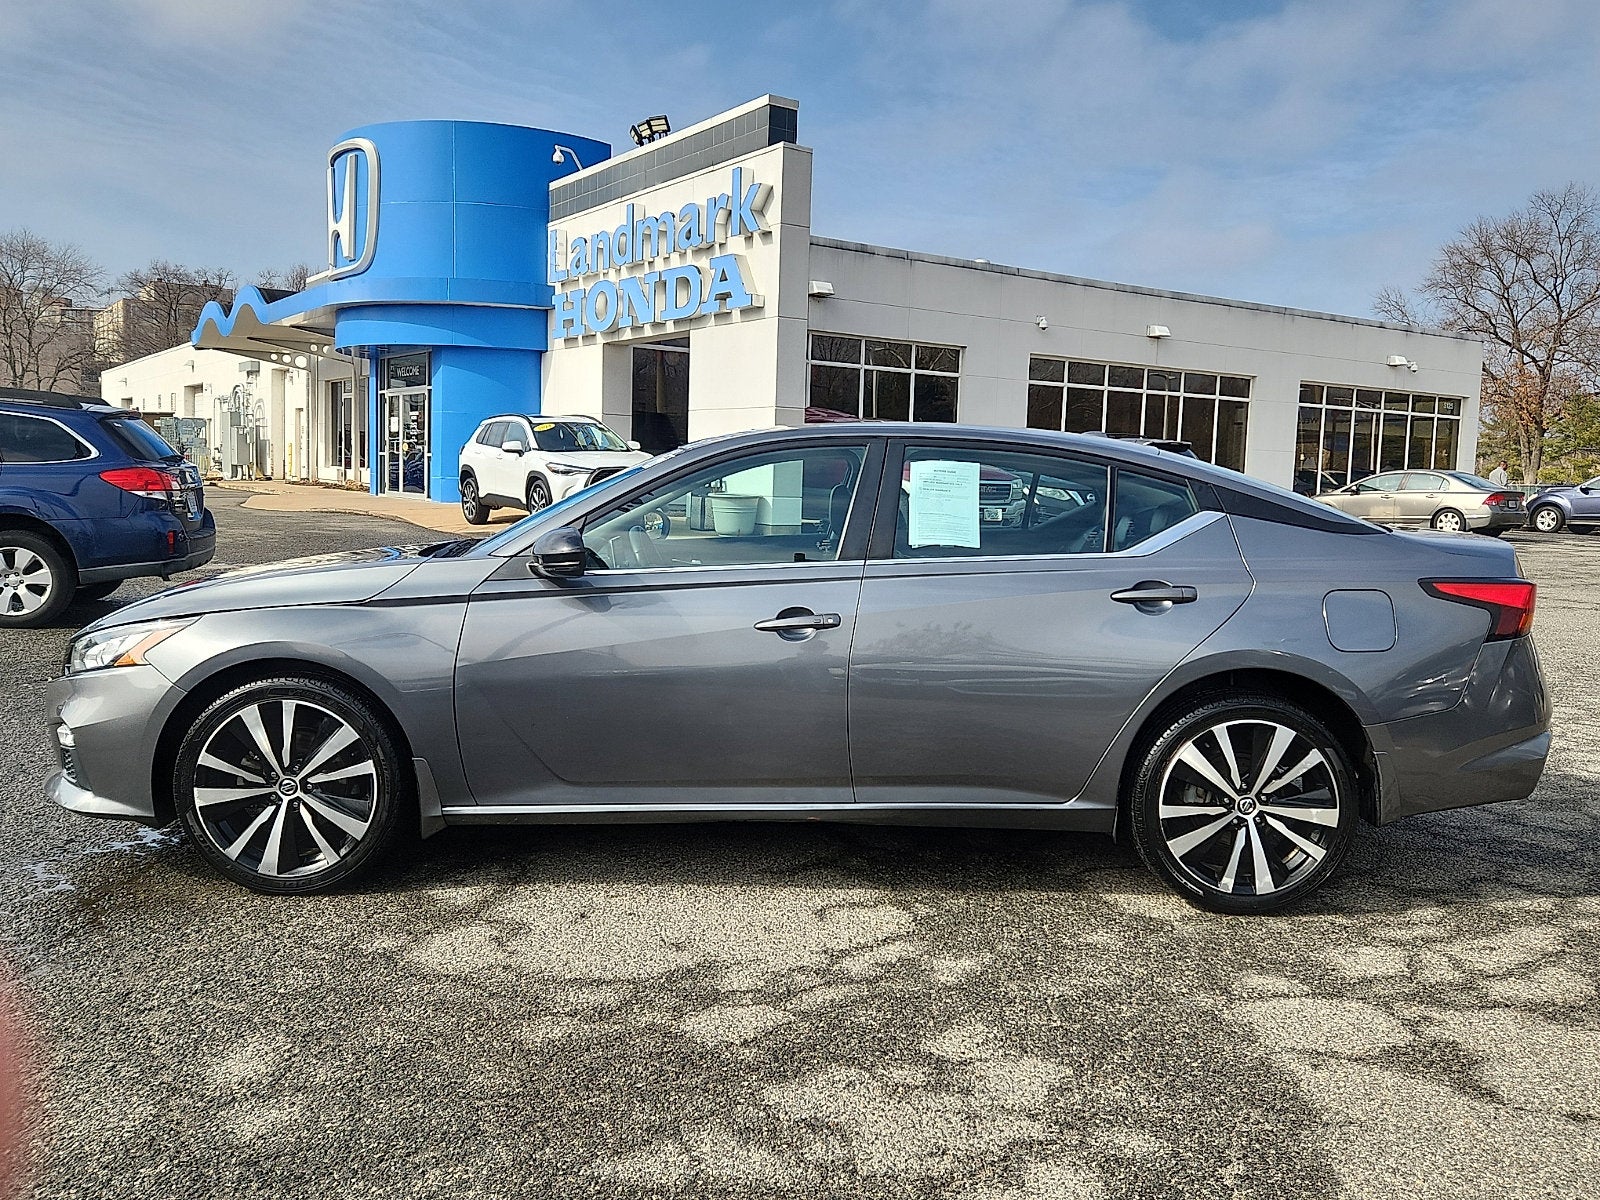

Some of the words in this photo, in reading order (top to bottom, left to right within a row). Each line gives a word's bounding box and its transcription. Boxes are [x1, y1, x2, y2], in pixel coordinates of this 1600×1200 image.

[549, 166, 767, 284] Landmark
[551, 253, 757, 340] HONDA
[396, 365, 420, 377] WELCOME
